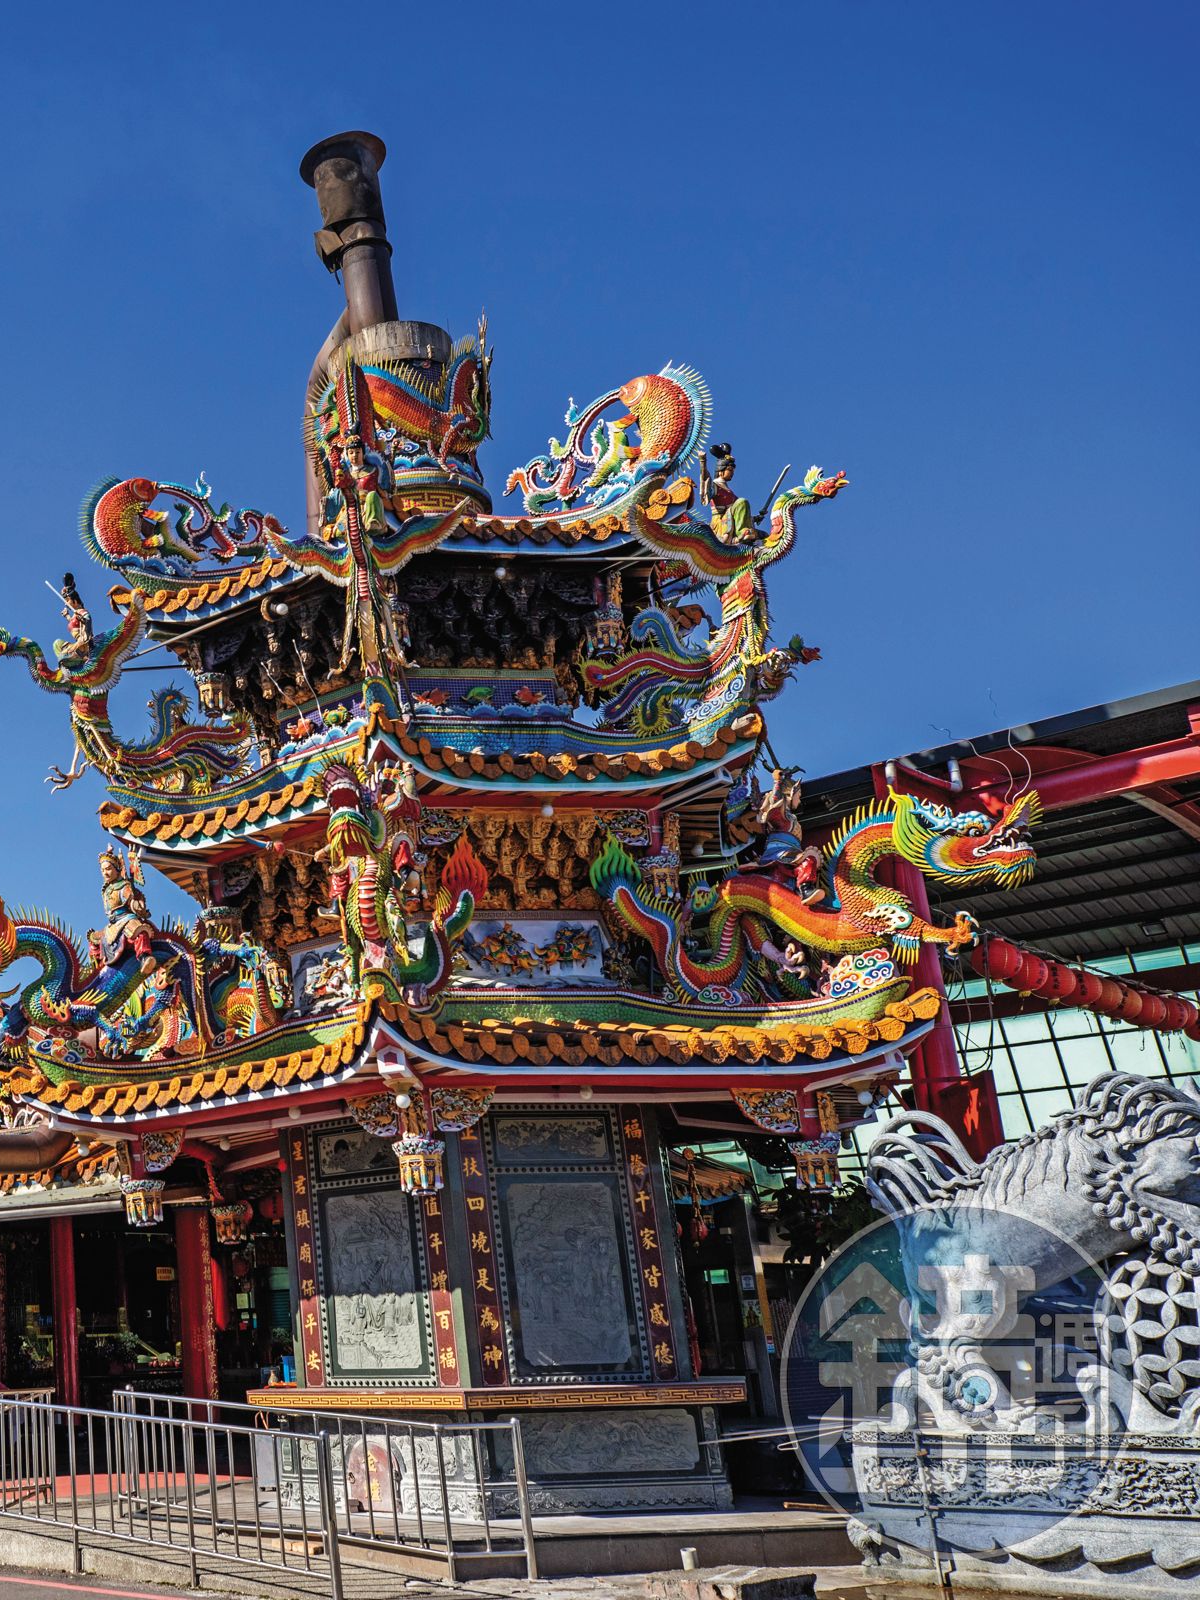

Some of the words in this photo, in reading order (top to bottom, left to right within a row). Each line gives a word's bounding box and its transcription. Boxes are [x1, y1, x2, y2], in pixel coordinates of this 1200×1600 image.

[425, 1197, 456, 1369] 值年增百福
